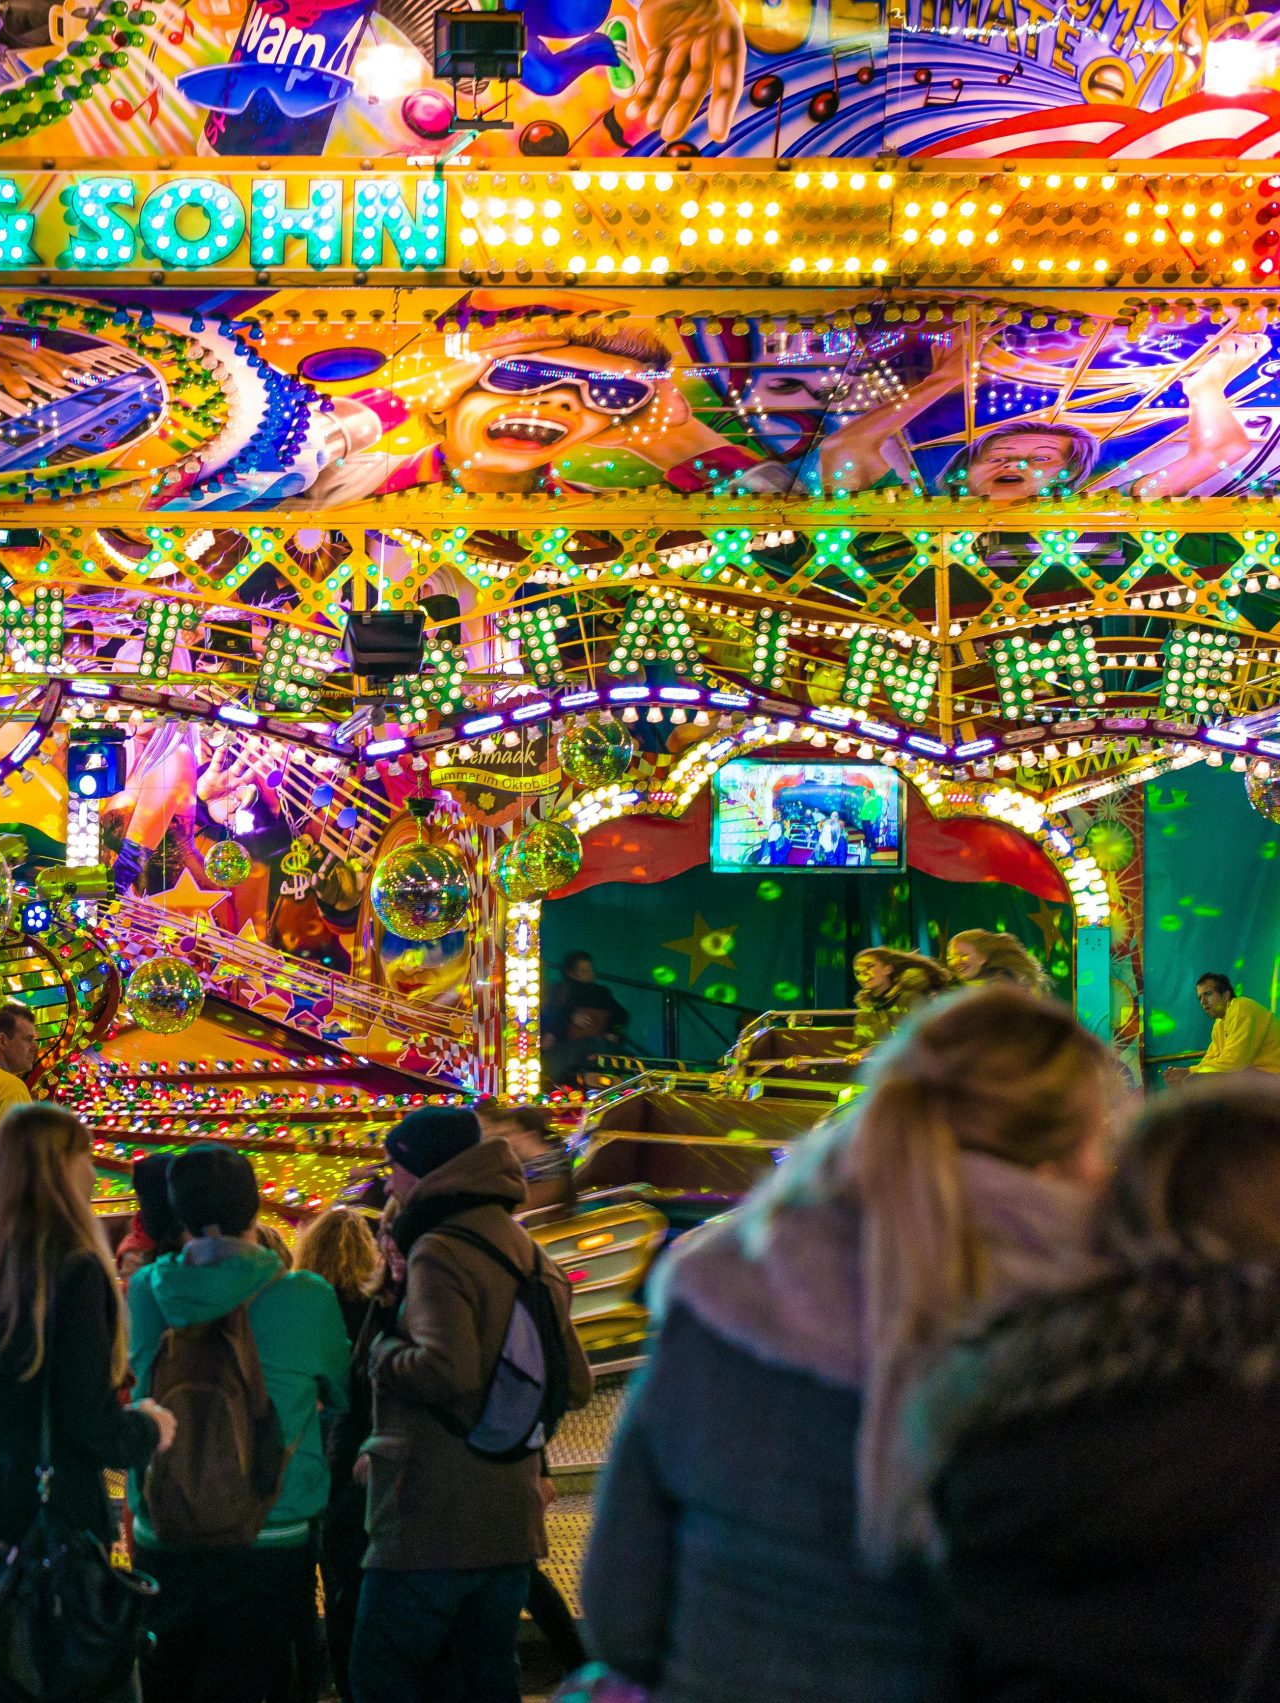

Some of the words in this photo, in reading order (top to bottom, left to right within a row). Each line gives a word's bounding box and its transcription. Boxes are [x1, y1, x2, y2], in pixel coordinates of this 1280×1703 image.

[69, 176, 447, 267] SOHN
[440, 770, 481, 783] immer
[483, 773, 499, 789] im
